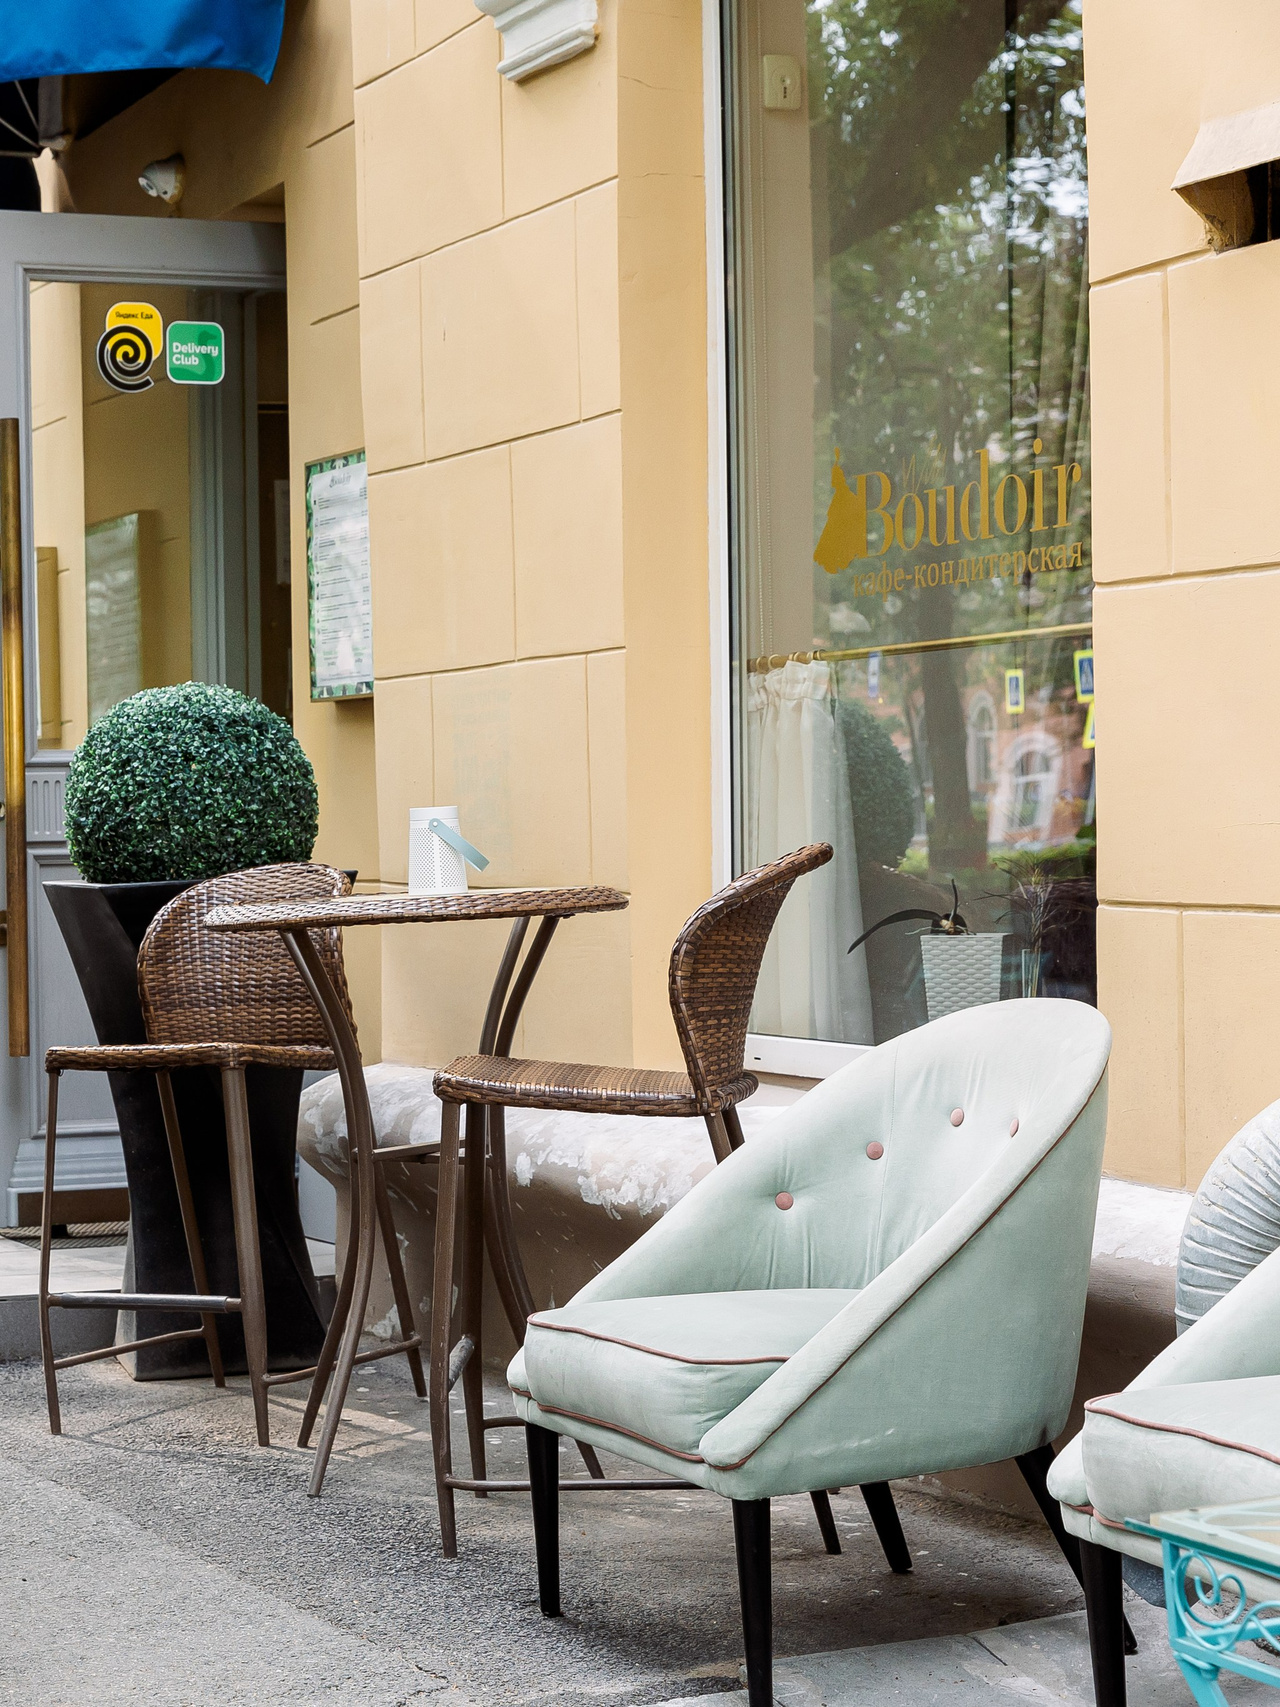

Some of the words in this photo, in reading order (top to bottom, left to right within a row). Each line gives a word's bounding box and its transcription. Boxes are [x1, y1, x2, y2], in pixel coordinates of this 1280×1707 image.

[115, 311, 139, 320] Яндекс
[140, 311, 154, 320] Еда
[172, 342, 219, 357] Delivery
[172, 353, 200, 366] Club
[852, 437, 1082, 559] Boudoir
[853, 541, 1083, 603] кафе-кондитерская
